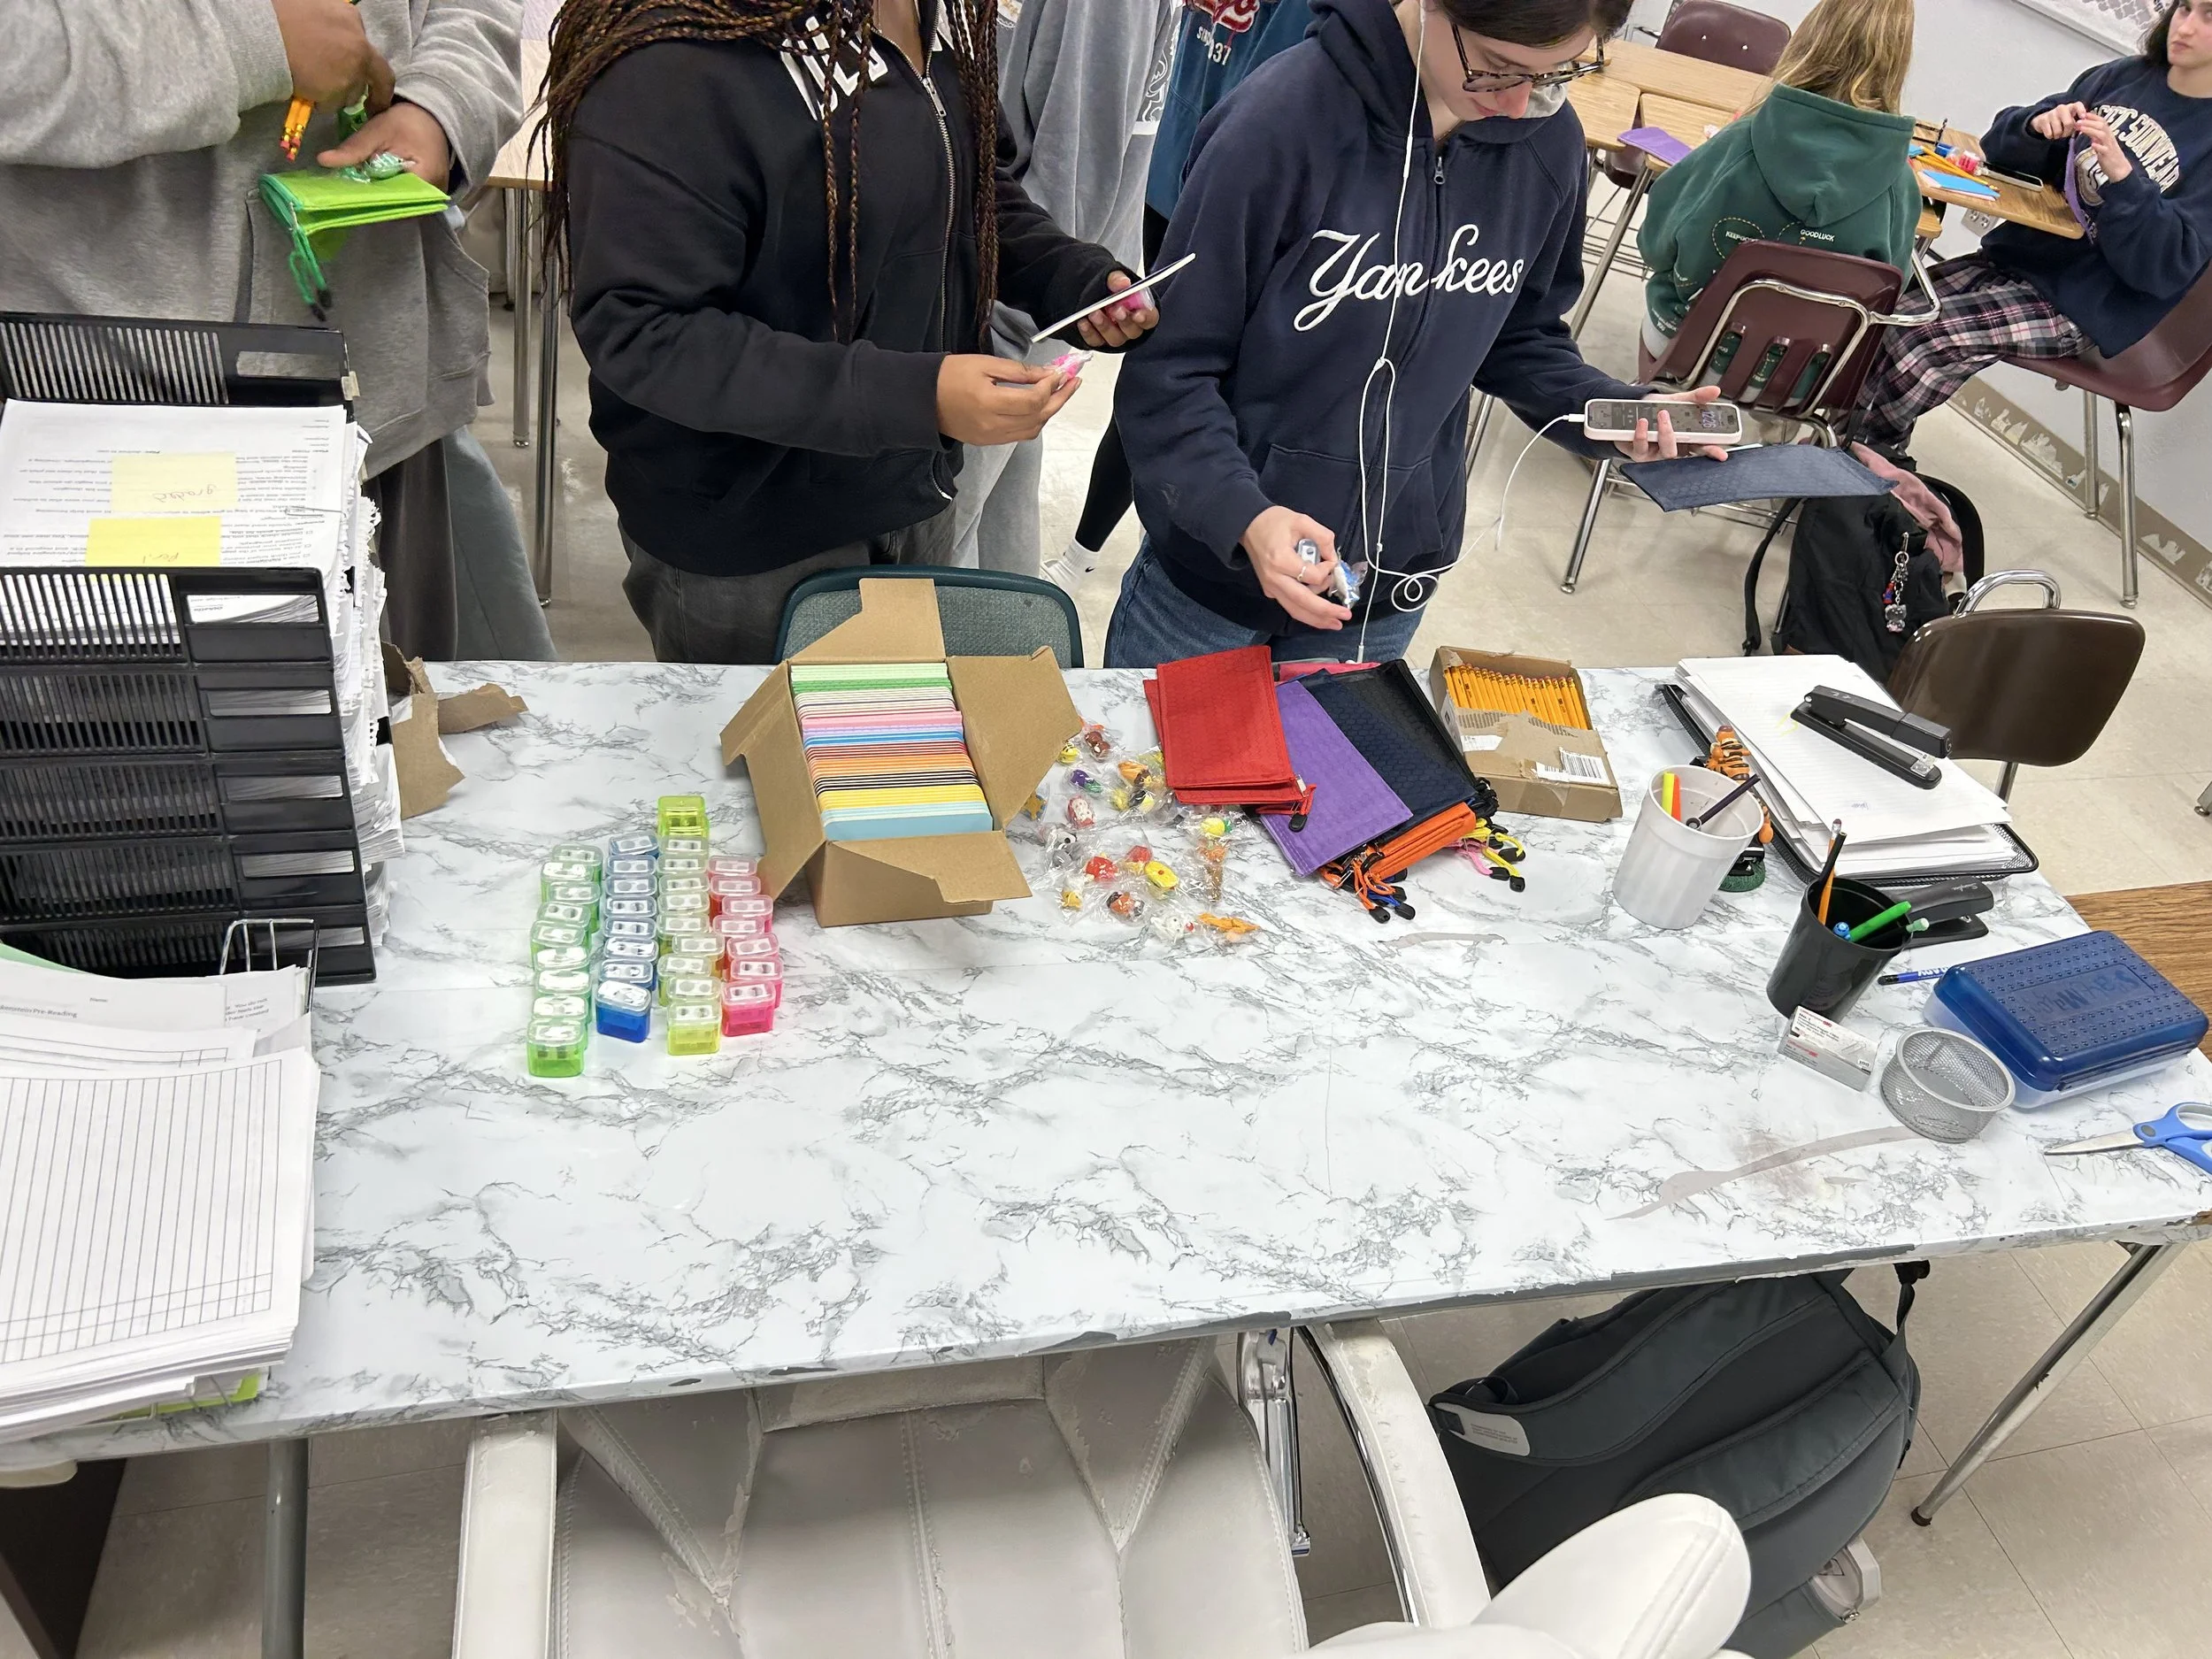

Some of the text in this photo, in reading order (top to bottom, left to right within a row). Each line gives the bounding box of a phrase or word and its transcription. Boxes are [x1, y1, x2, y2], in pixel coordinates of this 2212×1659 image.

[2118, 113, 2180, 194] SUNWEAR
[1293, 223, 1525, 332] Yankees
[33, 1007, 78, 1018] Pre-Reading
